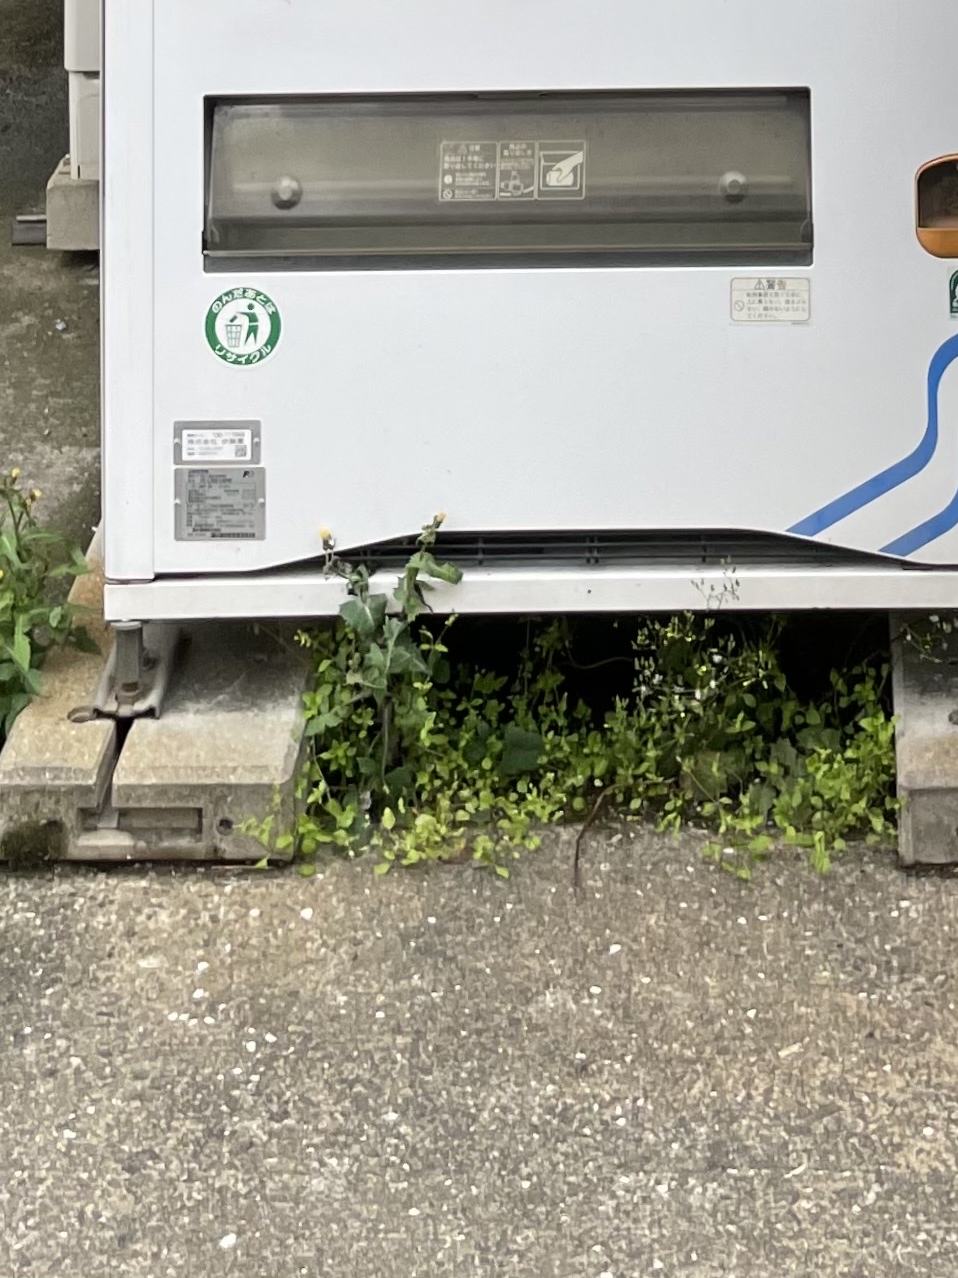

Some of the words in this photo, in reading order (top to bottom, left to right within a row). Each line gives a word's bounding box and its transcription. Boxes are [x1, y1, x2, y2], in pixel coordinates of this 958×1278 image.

[211, 287, 277, 315] のんだあとは
[214, 344, 272, 365] リサイクル
